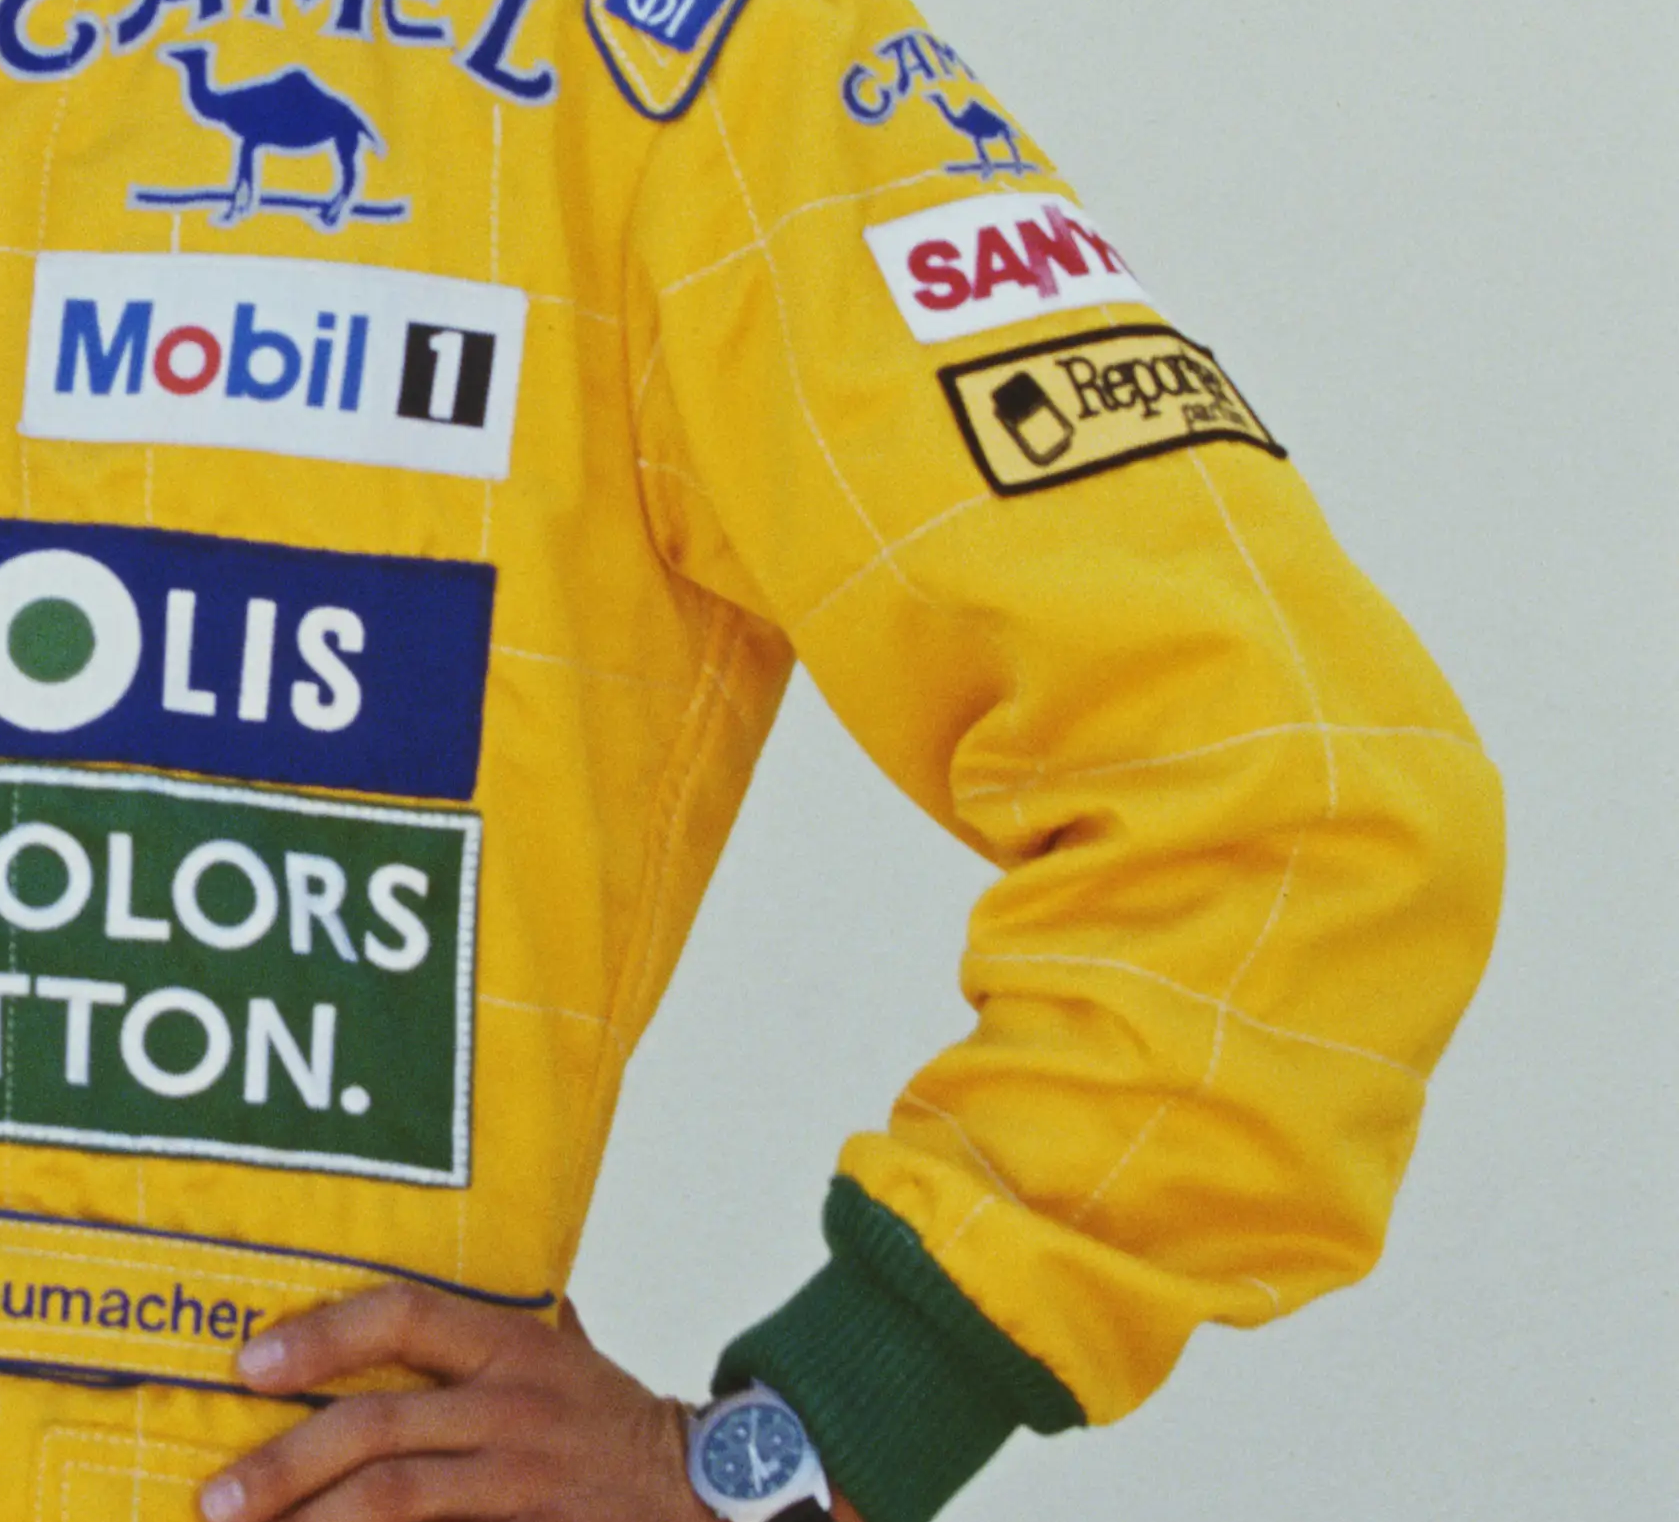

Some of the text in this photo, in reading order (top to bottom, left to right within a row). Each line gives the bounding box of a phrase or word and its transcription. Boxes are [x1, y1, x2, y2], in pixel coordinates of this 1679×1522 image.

[843, 31, 975, 123] CAM
[906, 204, 1132, 311] SANY
[54, 298, 369, 412] Mobil
